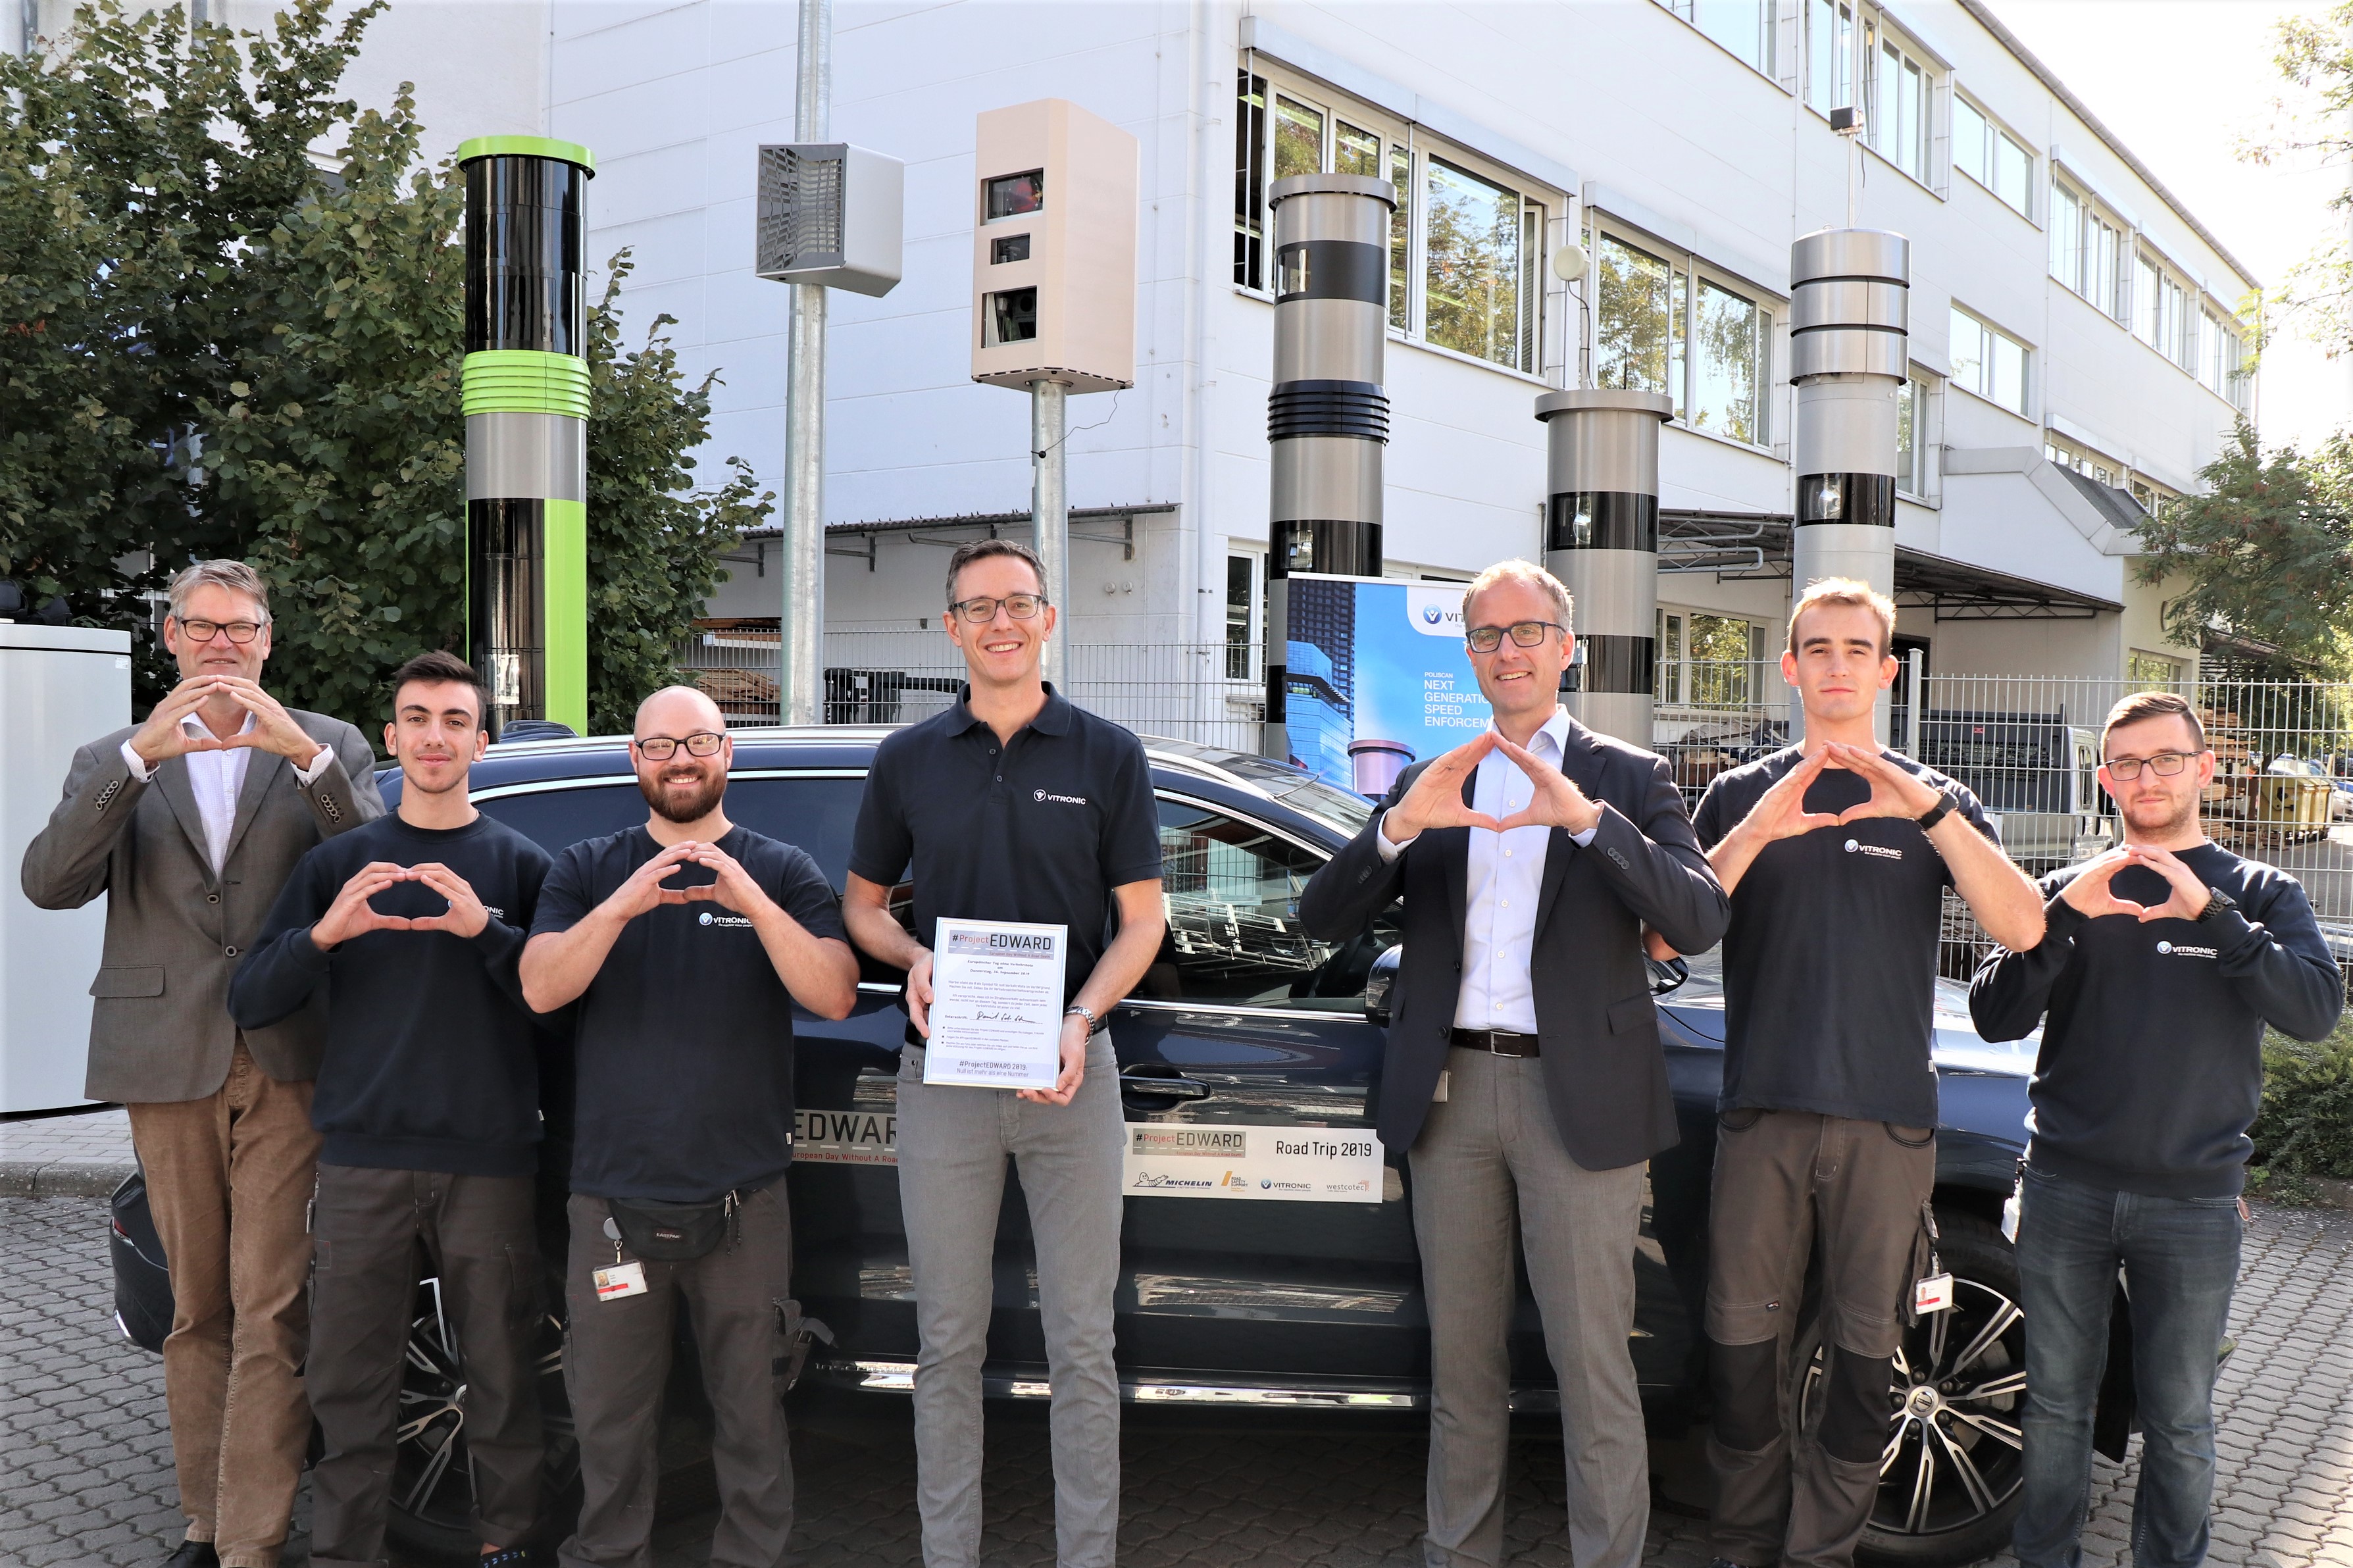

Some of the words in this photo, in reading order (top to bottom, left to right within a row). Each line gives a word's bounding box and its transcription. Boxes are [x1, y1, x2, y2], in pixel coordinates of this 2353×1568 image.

[1425, 680, 1454, 690] NEXT
[1425, 692, 1489, 703] GENERATIO
[1425, 704, 1462, 715] SPEED
[1425, 717, 1488, 728] ENFORCEM
[1048, 794, 1086, 805] VITRONIC
[1859, 845, 1902, 856] VITRONIC
[2173, 946, 2218, 955] VITRONIC
[959, 1060, 1011, 1071] #ProjectEDWARD
[795, 1113, 896, 1144] EDWAR
[1277, 1141, 1308, 1155] Road
[1313, 1142, 1337, 1159] Trip
[1341, 1143, 1371, 1157] 2019
[826, 1153, 839, 1161] Day
